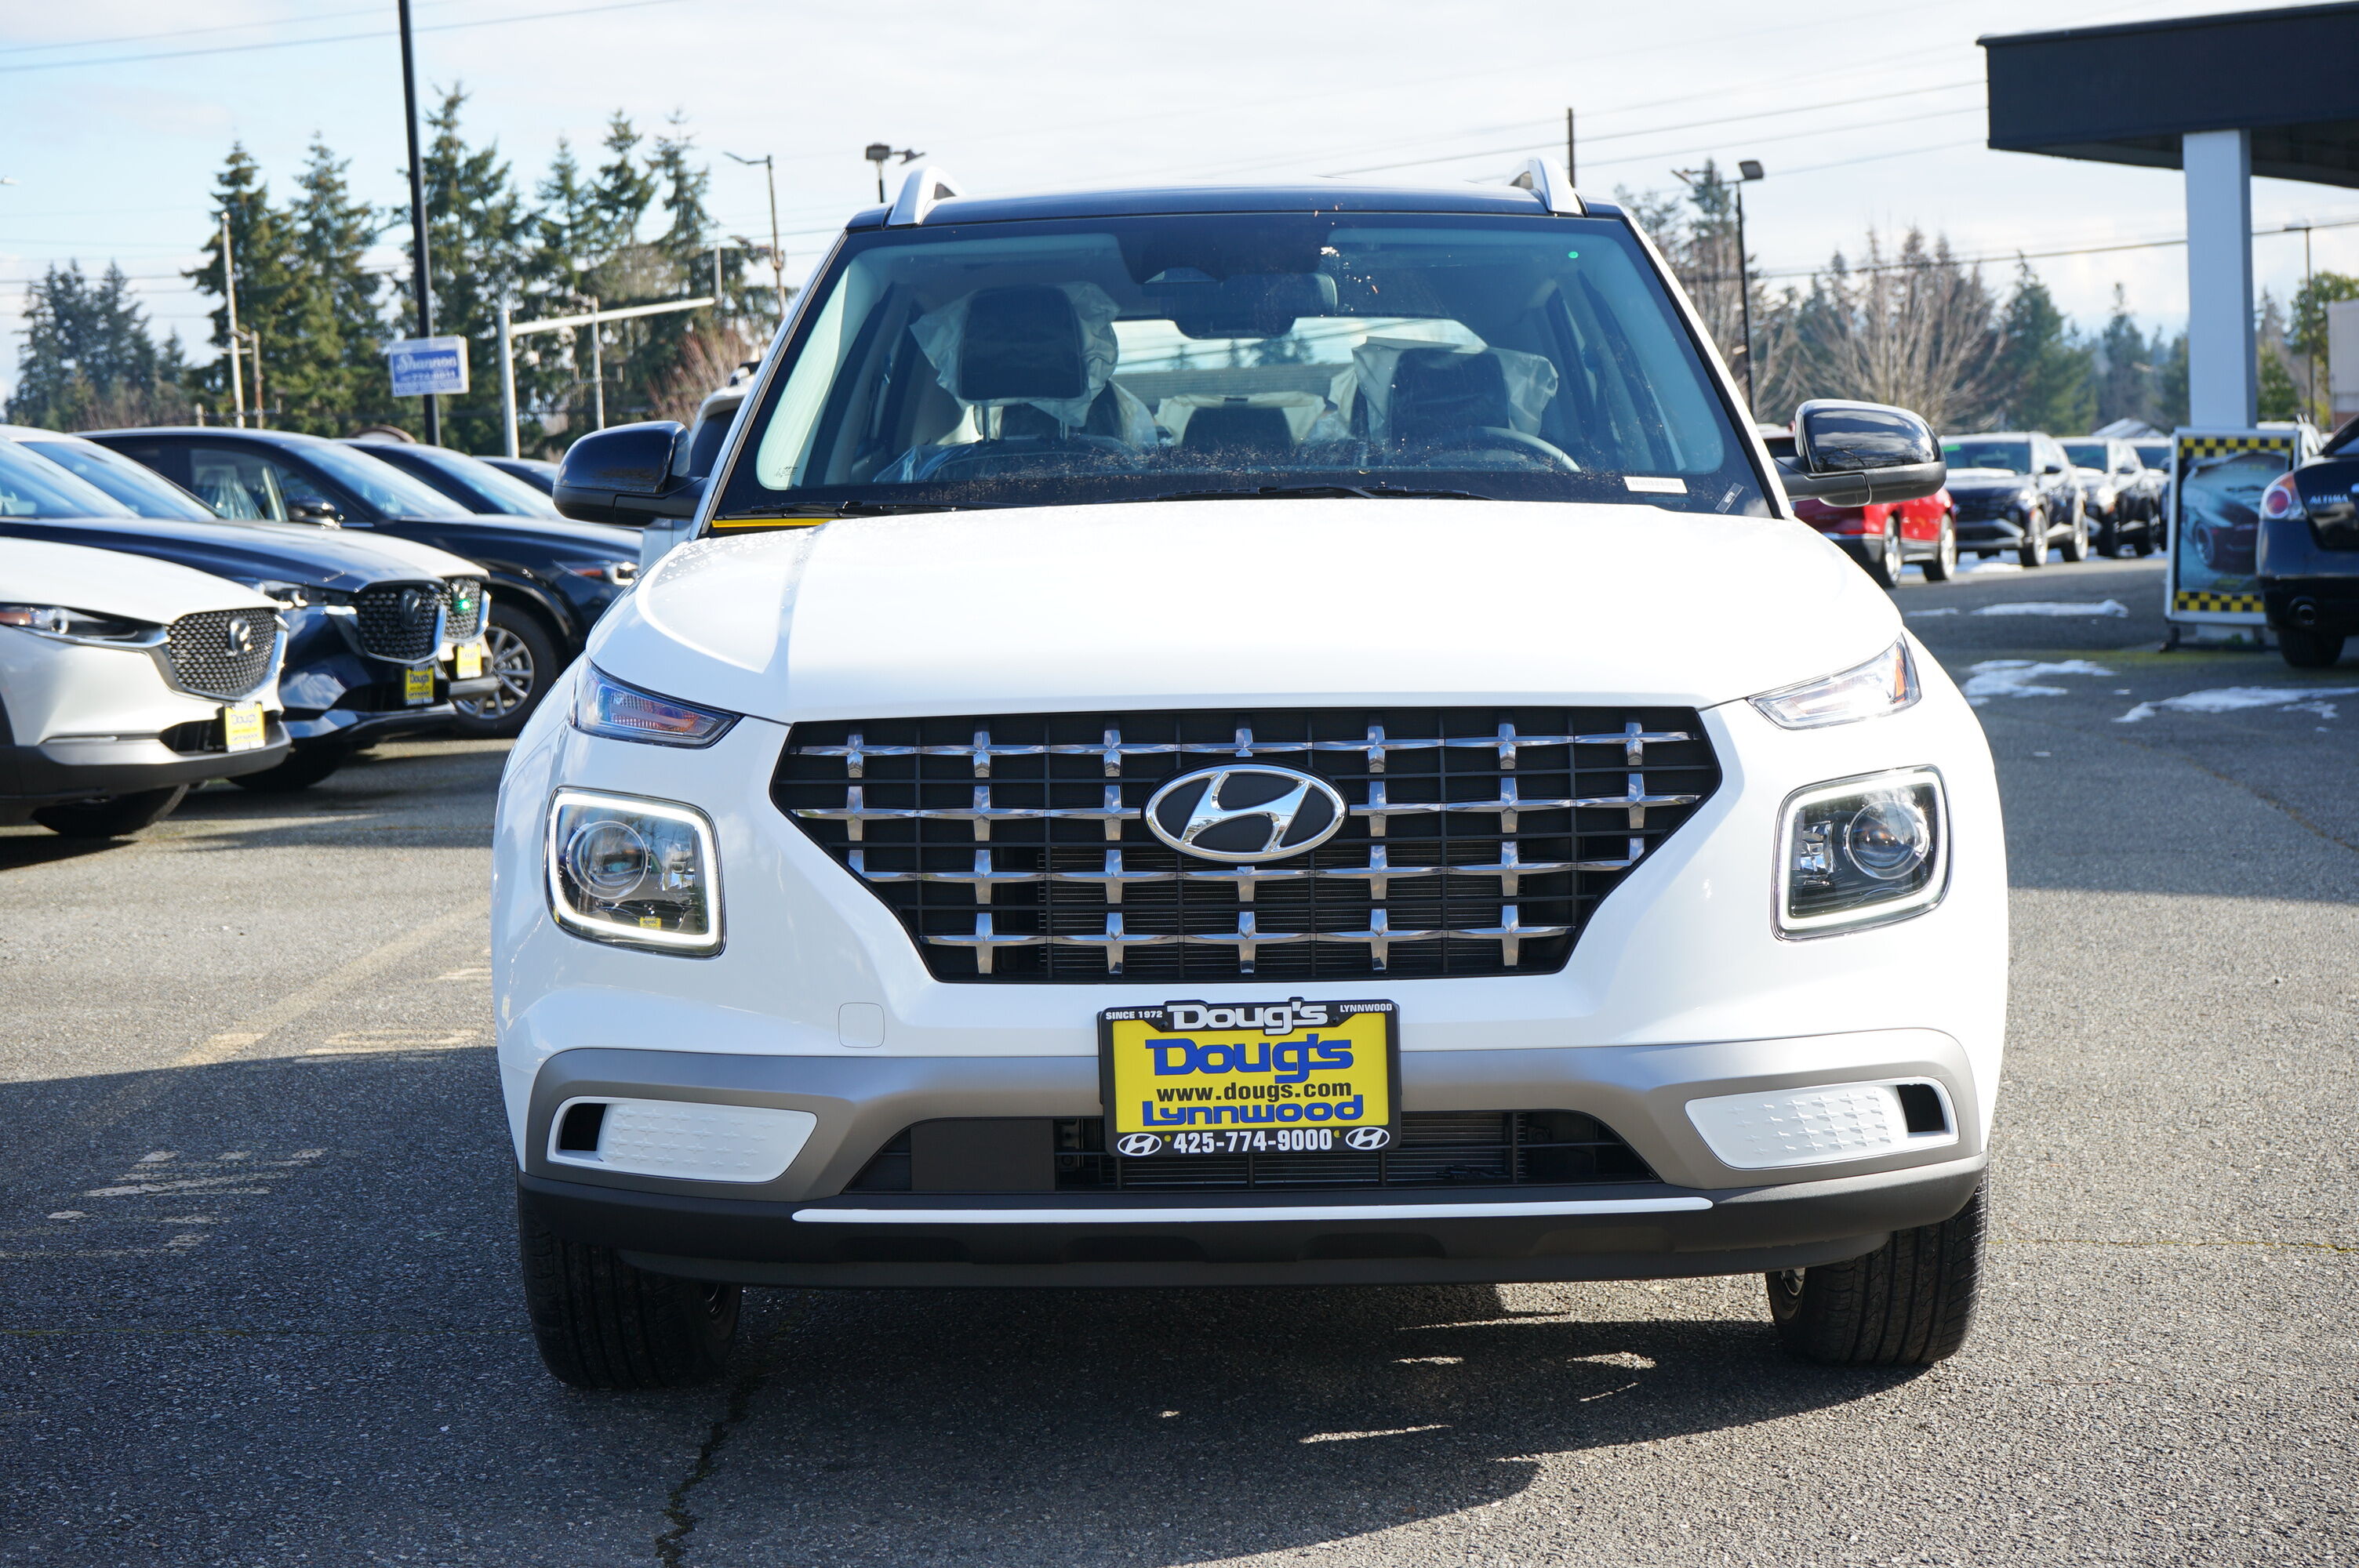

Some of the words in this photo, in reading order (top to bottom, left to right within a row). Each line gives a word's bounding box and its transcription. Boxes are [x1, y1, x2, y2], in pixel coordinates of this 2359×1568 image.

[2310, 494, 2349, 503] ALTIMA
[1106, 1011, 1136, 1020] SINCE
[1138, 1010, 1163, 1019] 1972
[1167, 1001, 1328, 1035] Doug's
[1339, 1004, 1393, 1013] LYNNWOOD
[1145, 1033, 1354, 1083] Doug's
[1156, 1082, 1351, 1102] www.dougs.com
[1142, 1094, 1364, 1127] Lynnwood
[1173, 1128, 1332, 1154] 425-774-9000
